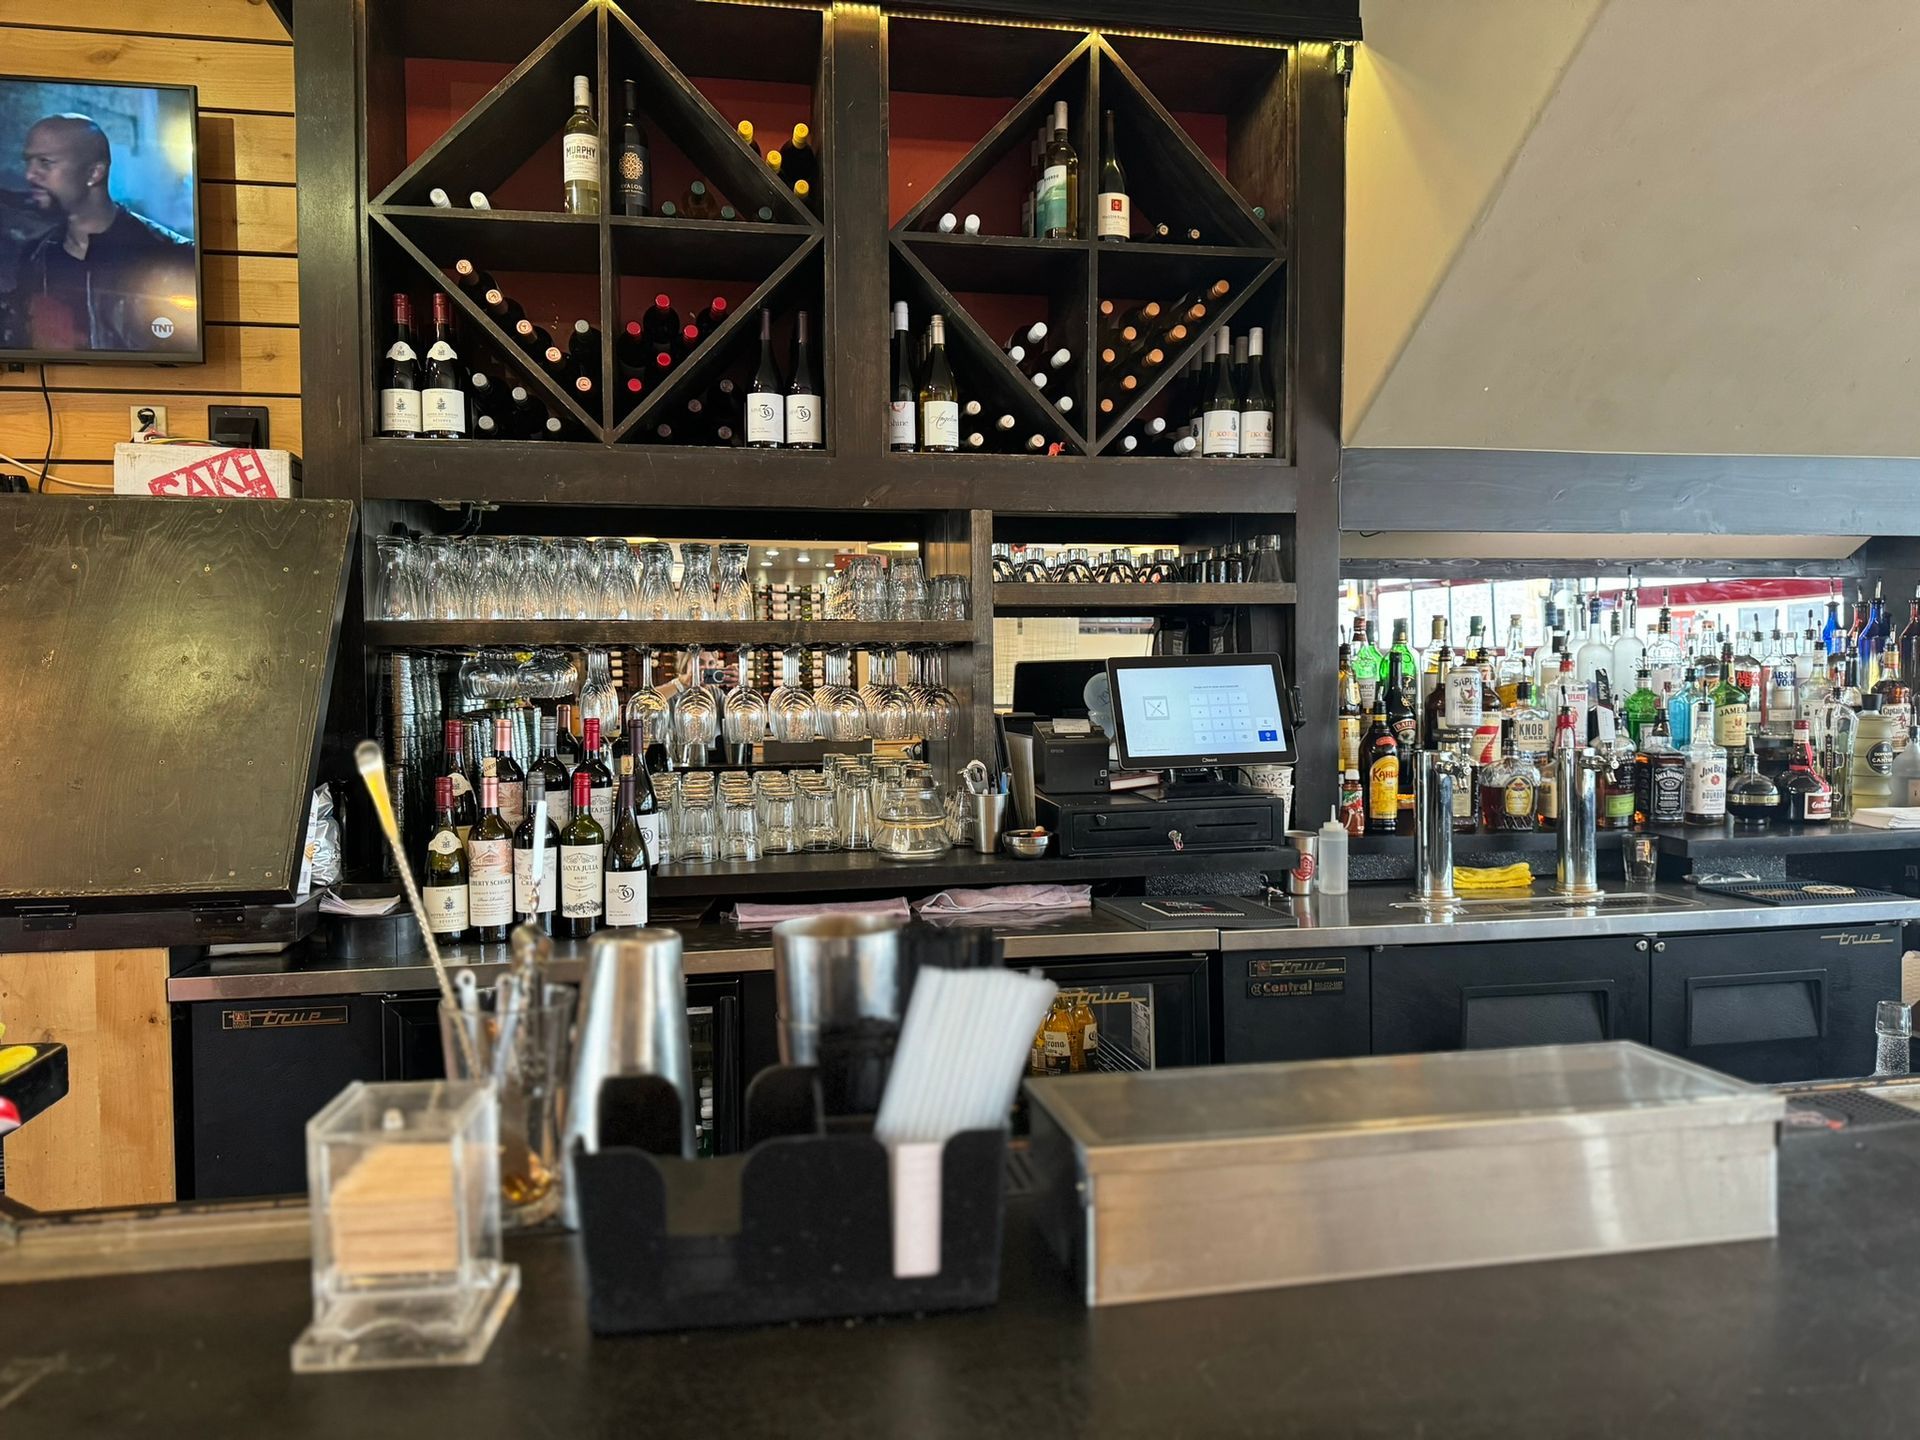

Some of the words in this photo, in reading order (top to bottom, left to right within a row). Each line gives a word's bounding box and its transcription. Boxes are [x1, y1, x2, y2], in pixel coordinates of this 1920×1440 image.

[566, 145, 596, 158] MURPHY
[152, 323, 174, 333] TNT
[1719, 706, 1747, 717] JAMES
[1520, 723, 1544, 736] KNOB
[1473, 725, 1500, 764] 7
[1699, 766, 1713, 778] JIM
[582, 864, 599, 872] JULIA
[618, 884, 635, 904] 39
[1262, 979, 1312, 993] Central
[263, 1010, 321, 1026] true
